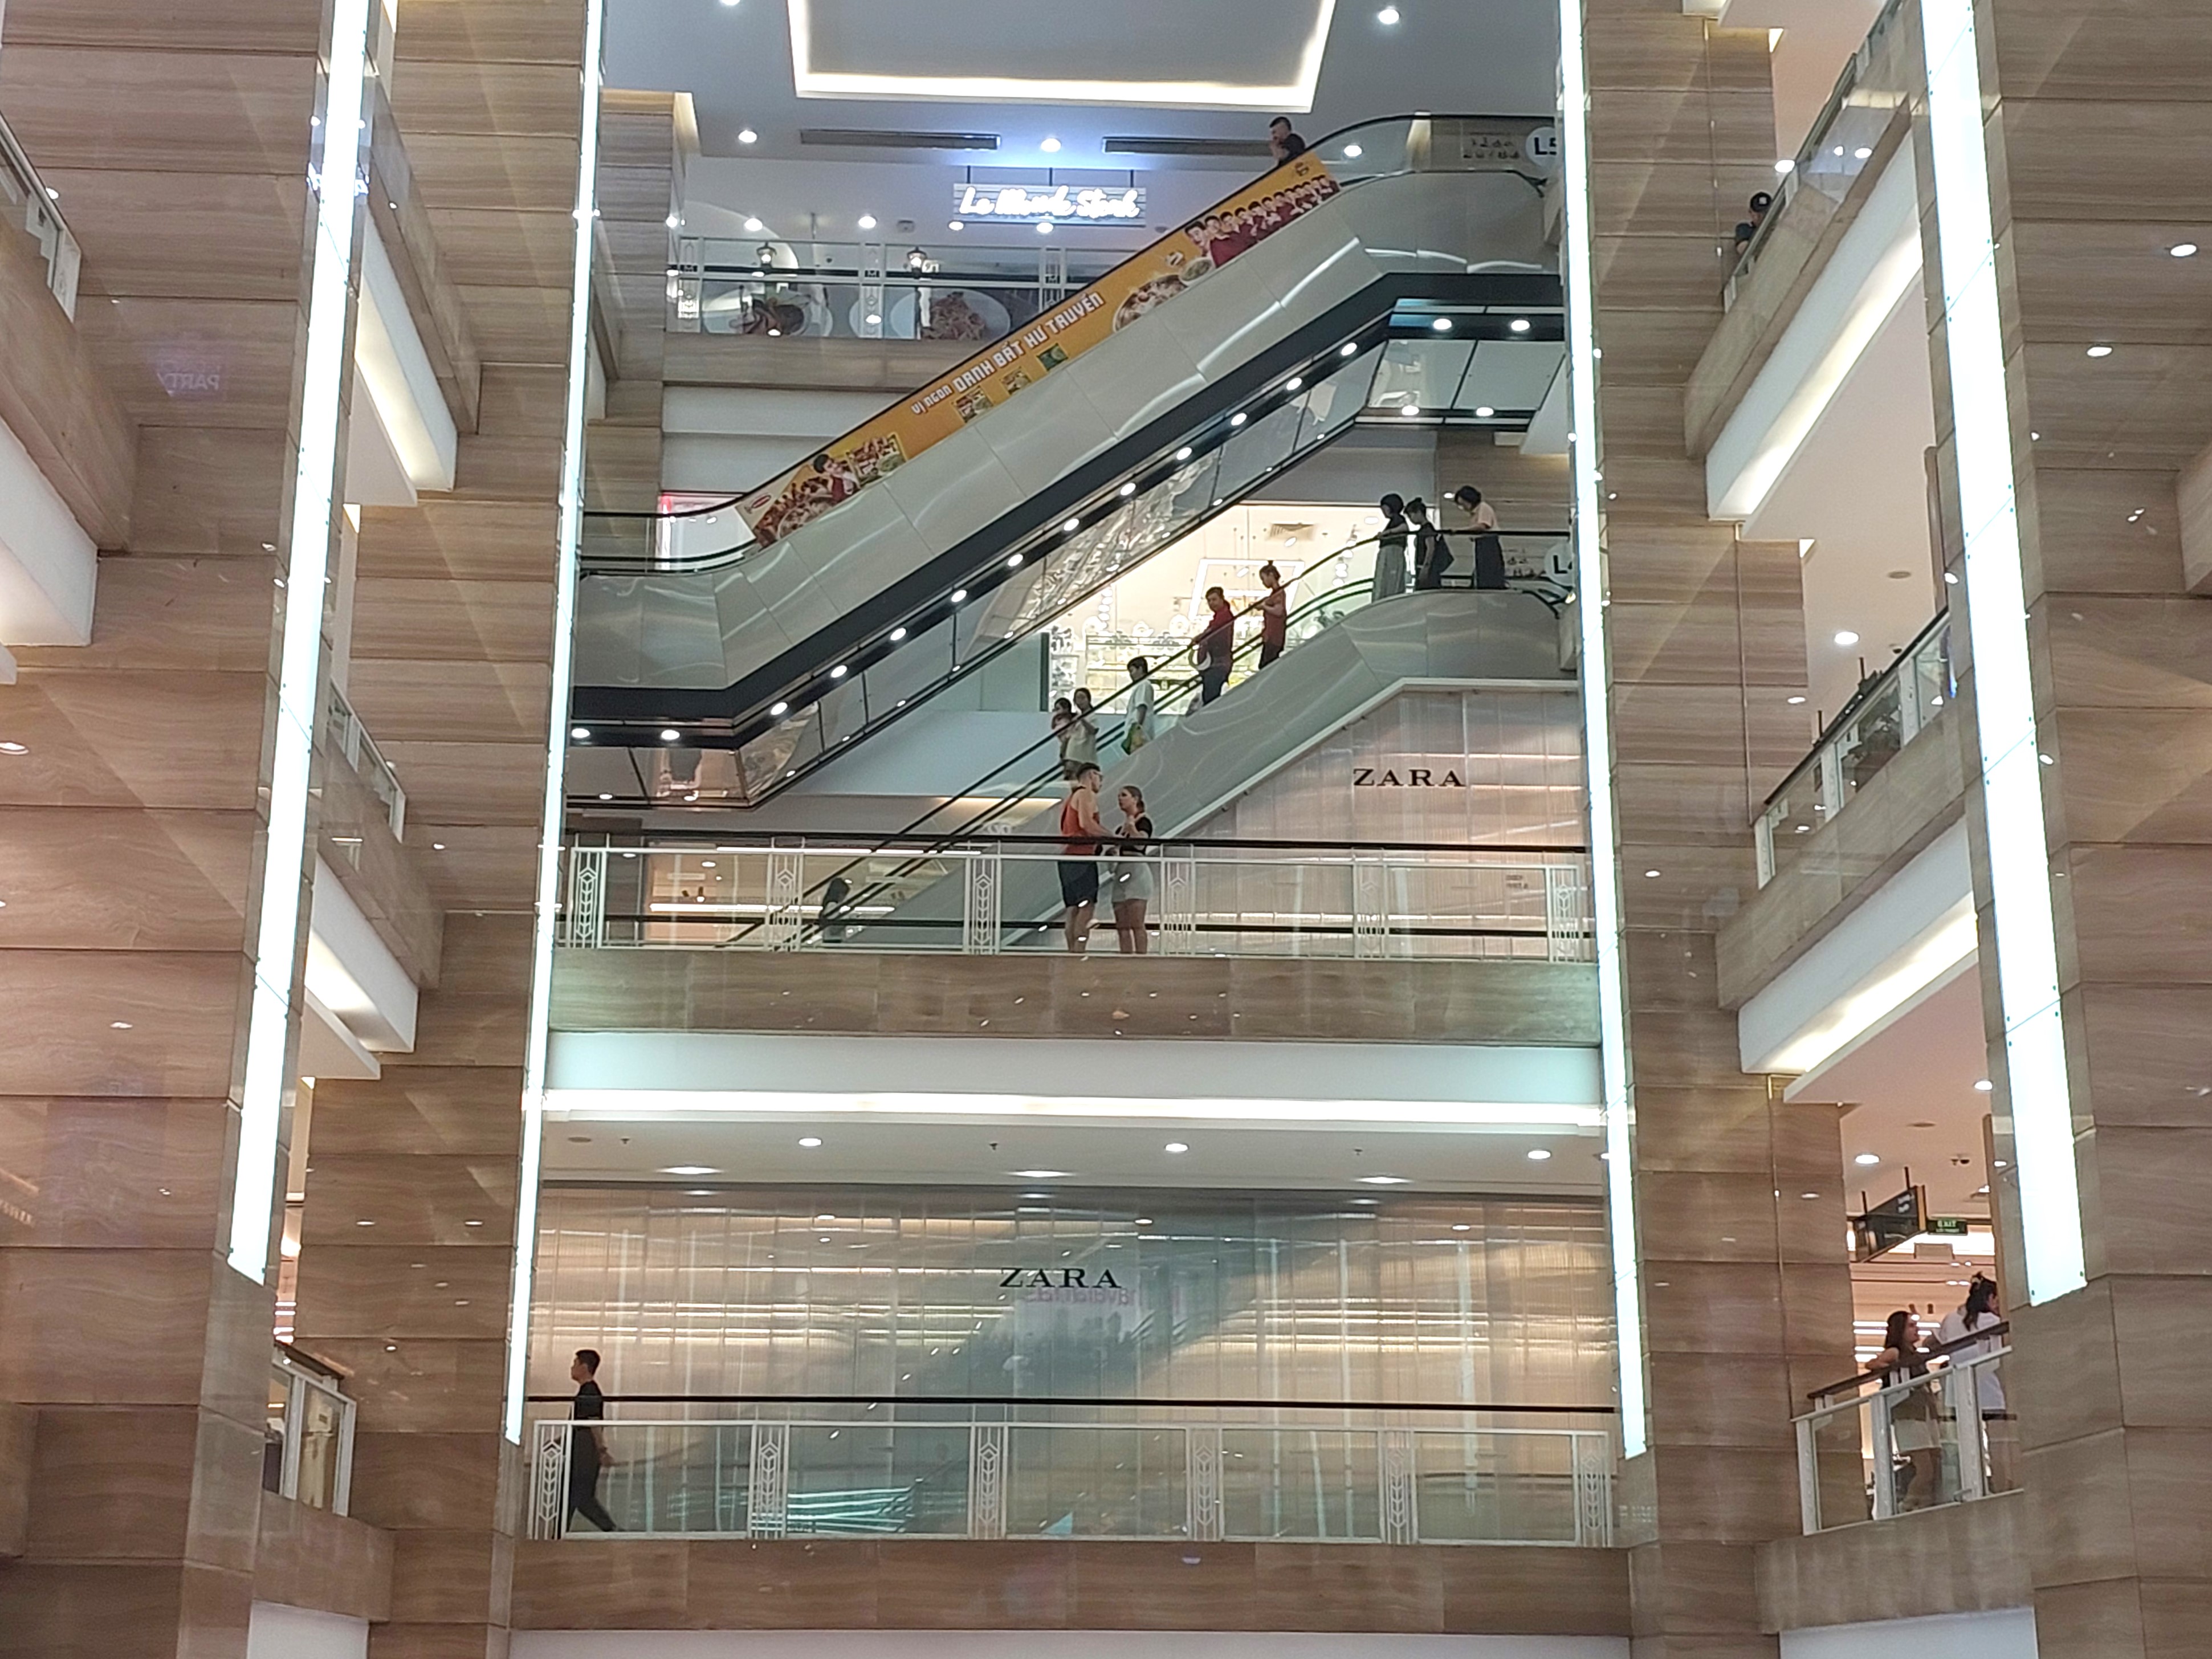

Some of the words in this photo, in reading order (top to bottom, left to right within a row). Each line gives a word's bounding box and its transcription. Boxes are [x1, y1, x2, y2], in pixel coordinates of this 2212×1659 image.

[952, 359, 996, 393] DANH
[1353, 768, 1466, 787] ZARA
[1000, 1267, 1122, 1289] ZARA
